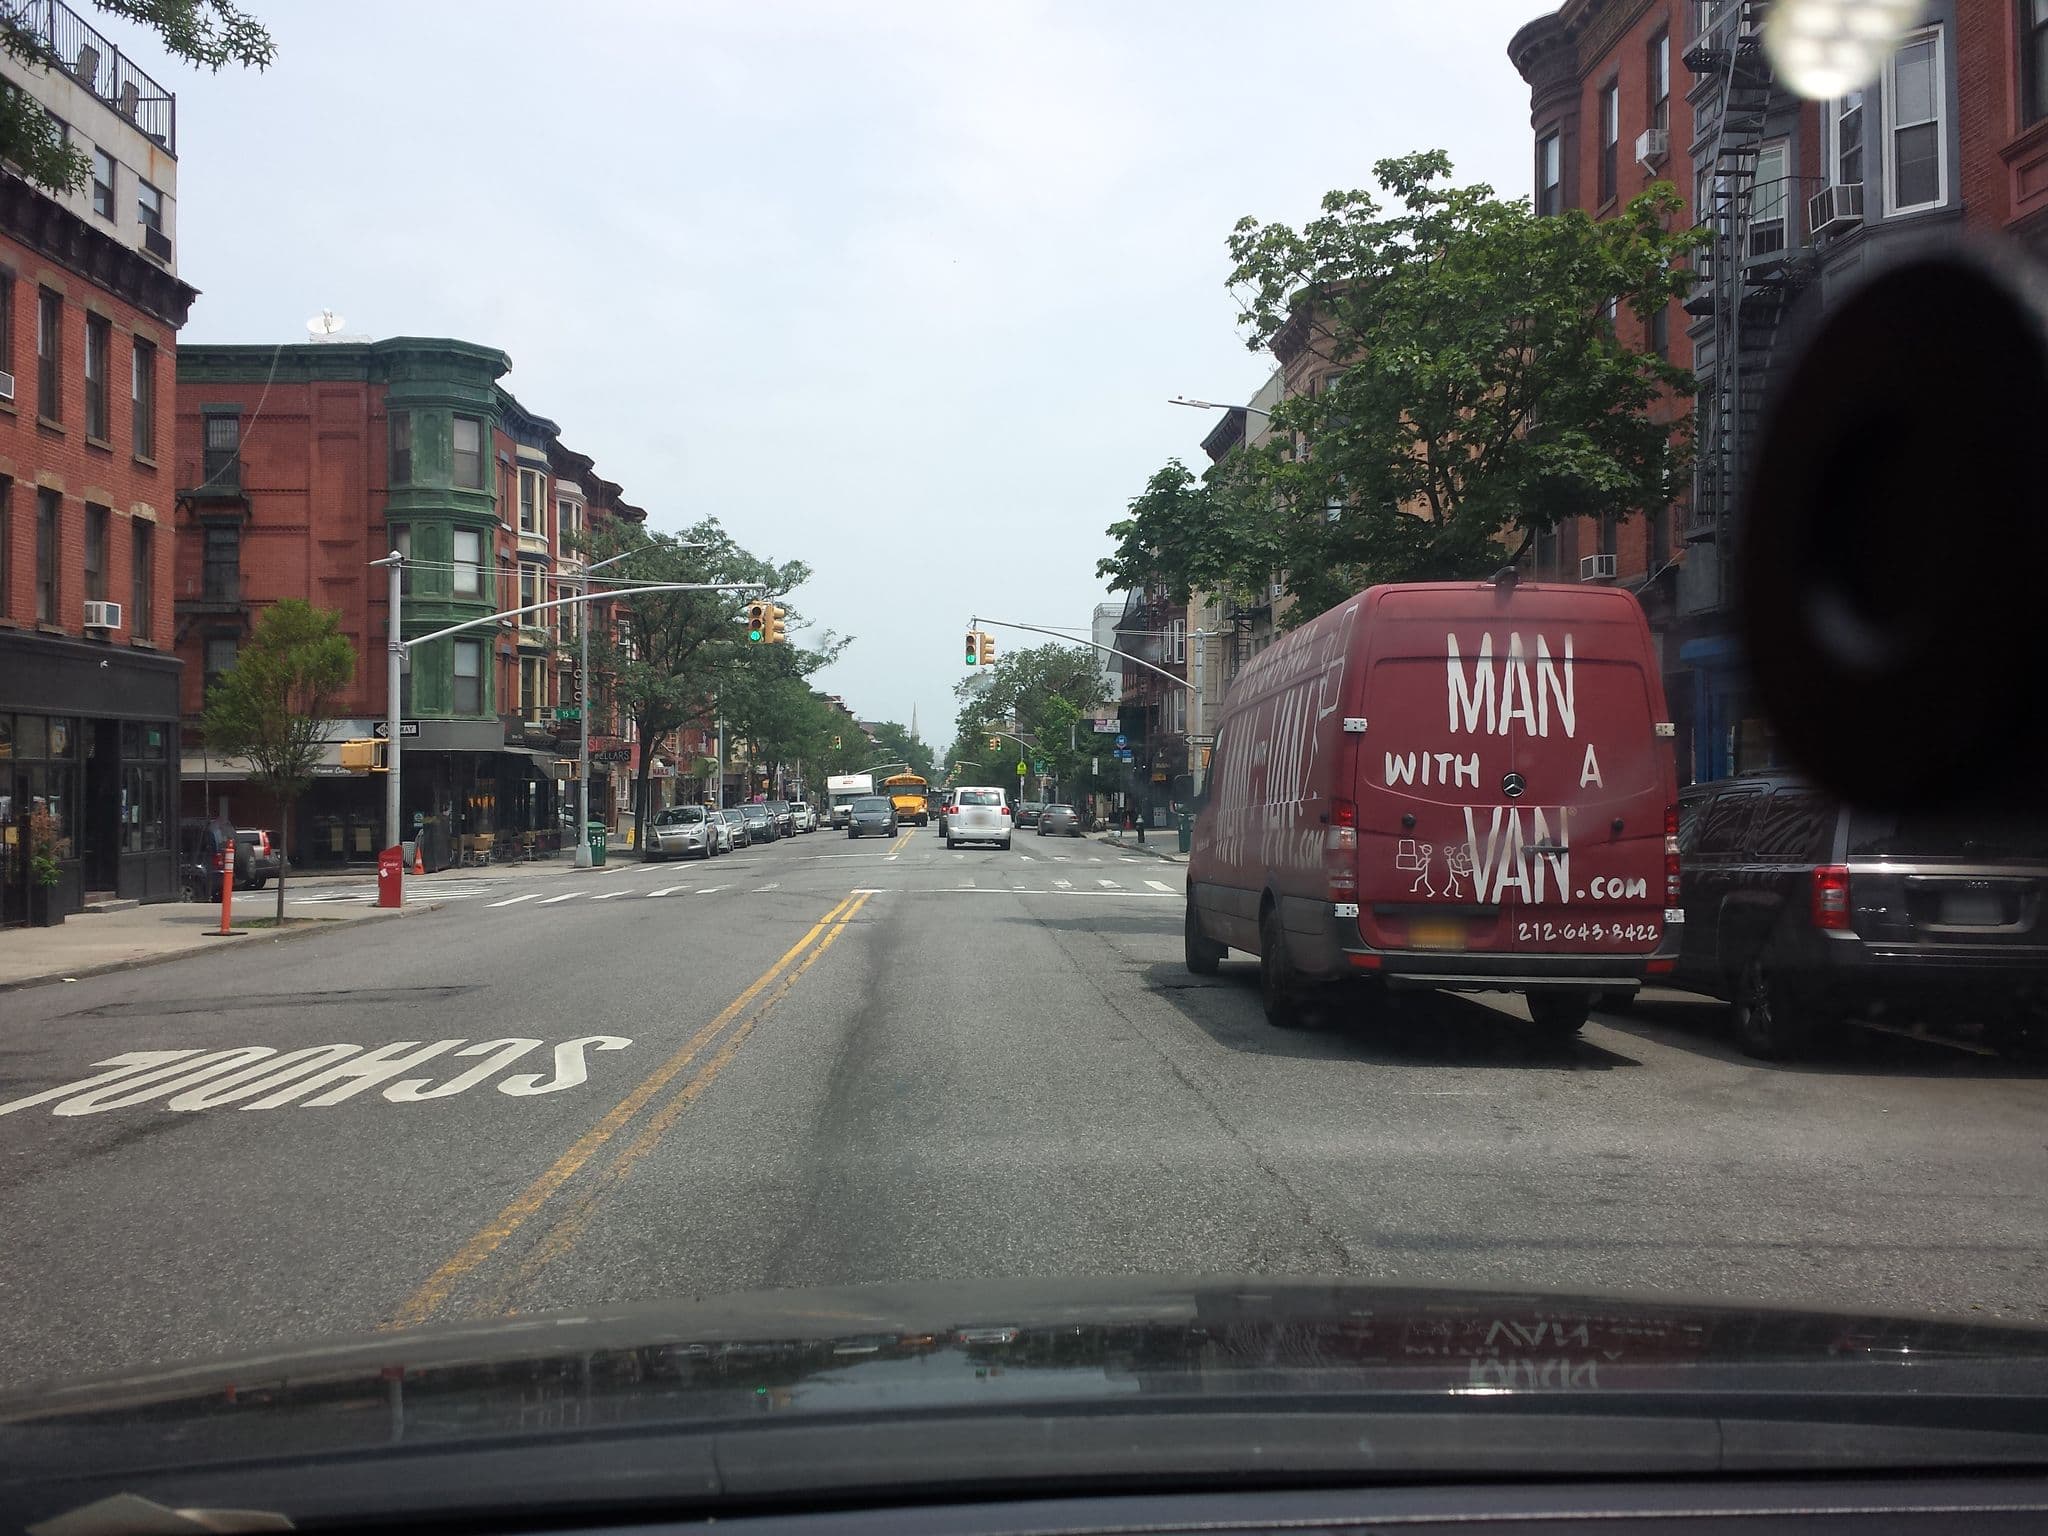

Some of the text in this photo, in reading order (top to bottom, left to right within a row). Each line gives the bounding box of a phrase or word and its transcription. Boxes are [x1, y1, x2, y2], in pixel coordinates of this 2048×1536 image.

[1447, 632, 1575, 737] MAN
[1385, 743, 1603, 788] WITH A
[0, 1036, 634, 1117] SCHOOL
